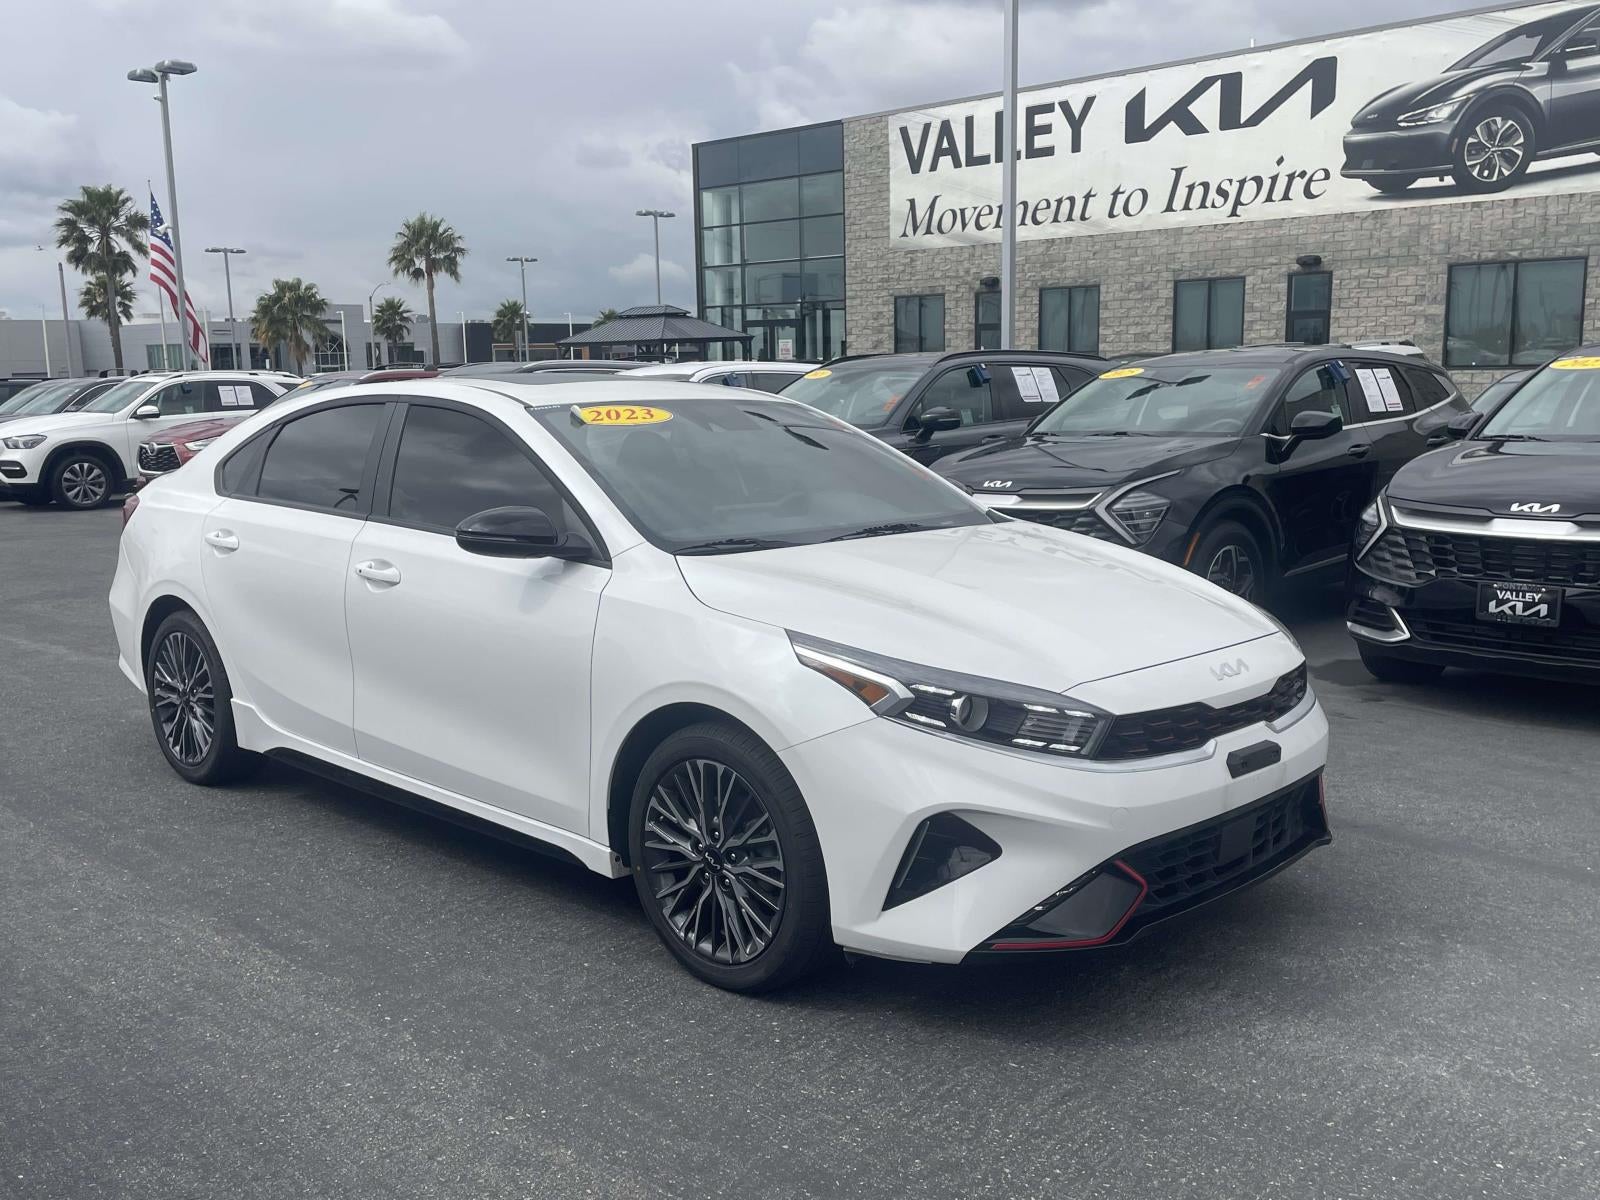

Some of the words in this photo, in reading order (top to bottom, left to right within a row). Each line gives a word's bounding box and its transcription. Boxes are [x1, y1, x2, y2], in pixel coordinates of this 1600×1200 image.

[899, 95, 1097, 174] VALLEY
[1125, 56, 1338, 144] KIA
[899, 186, 1099, 239] Movement
[1107, 183, 1149, 219] to
[1160, 155, 1331, 218] Inspire
[589, 408, 655, 422] 2023
[1510, 502, 1561, 513] KIA
[1496, 589, 1542, 602] VALLEY
[1488, 600, 1548, 617] KIA
